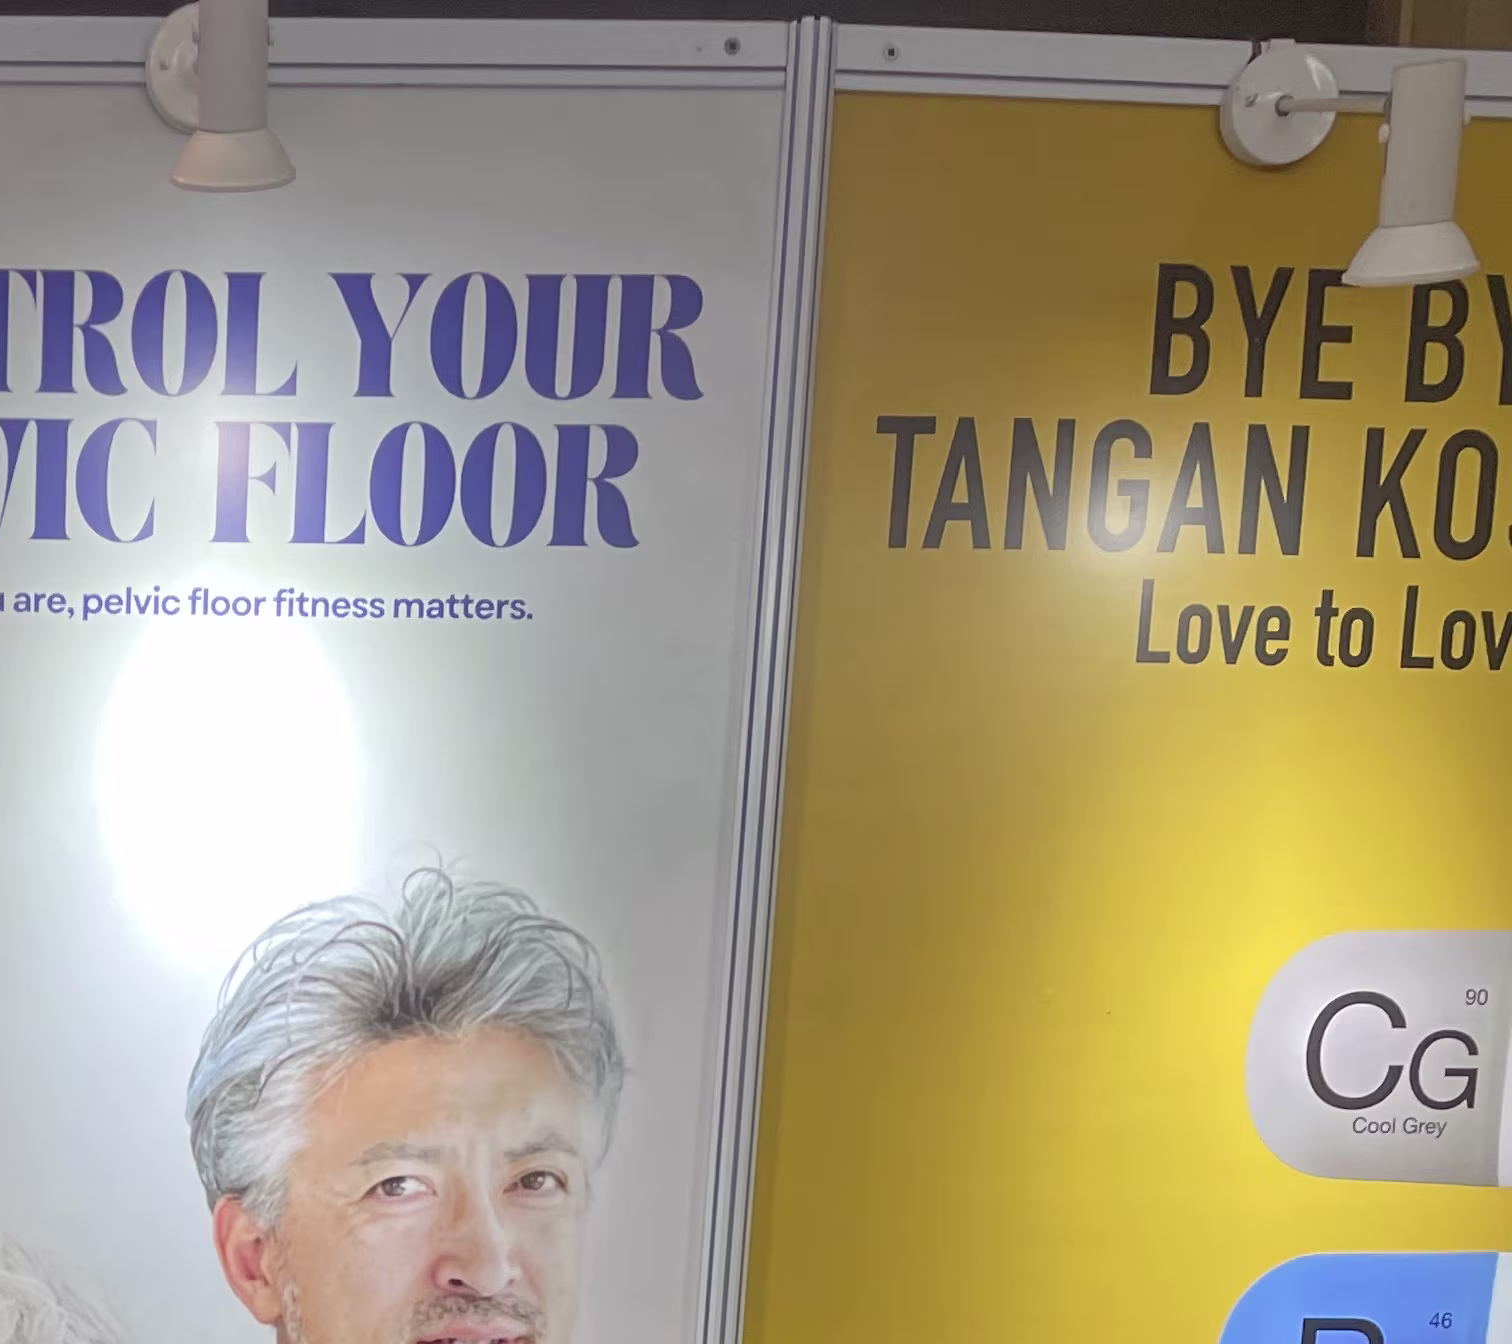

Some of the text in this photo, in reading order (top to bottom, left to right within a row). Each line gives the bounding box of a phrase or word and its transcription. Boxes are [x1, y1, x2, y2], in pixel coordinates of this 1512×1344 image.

[329, 271, 706, 402] YOUR
[1149, 262, 1354, 401] BYE
[210, 419, 642, 550] FLOOR
[875, 414, 1512, 562] TANGAN KO
[12, 590, 76, 619] are,
[82, 584, 181, 621] pelvic
[188, 586, 267, 617] floor
[273, 586, 386, 620] fitness
[393, 593, 534, 621] matters.
[1135, 577, 1292, 667] Love
[1314, 589, 1376, 669] to
[1464, 988, 1489, 1006] 90
[1351, 1116, 1448, 1139] Cool Grey
[1428, 1312, 1453, 1329] 46
